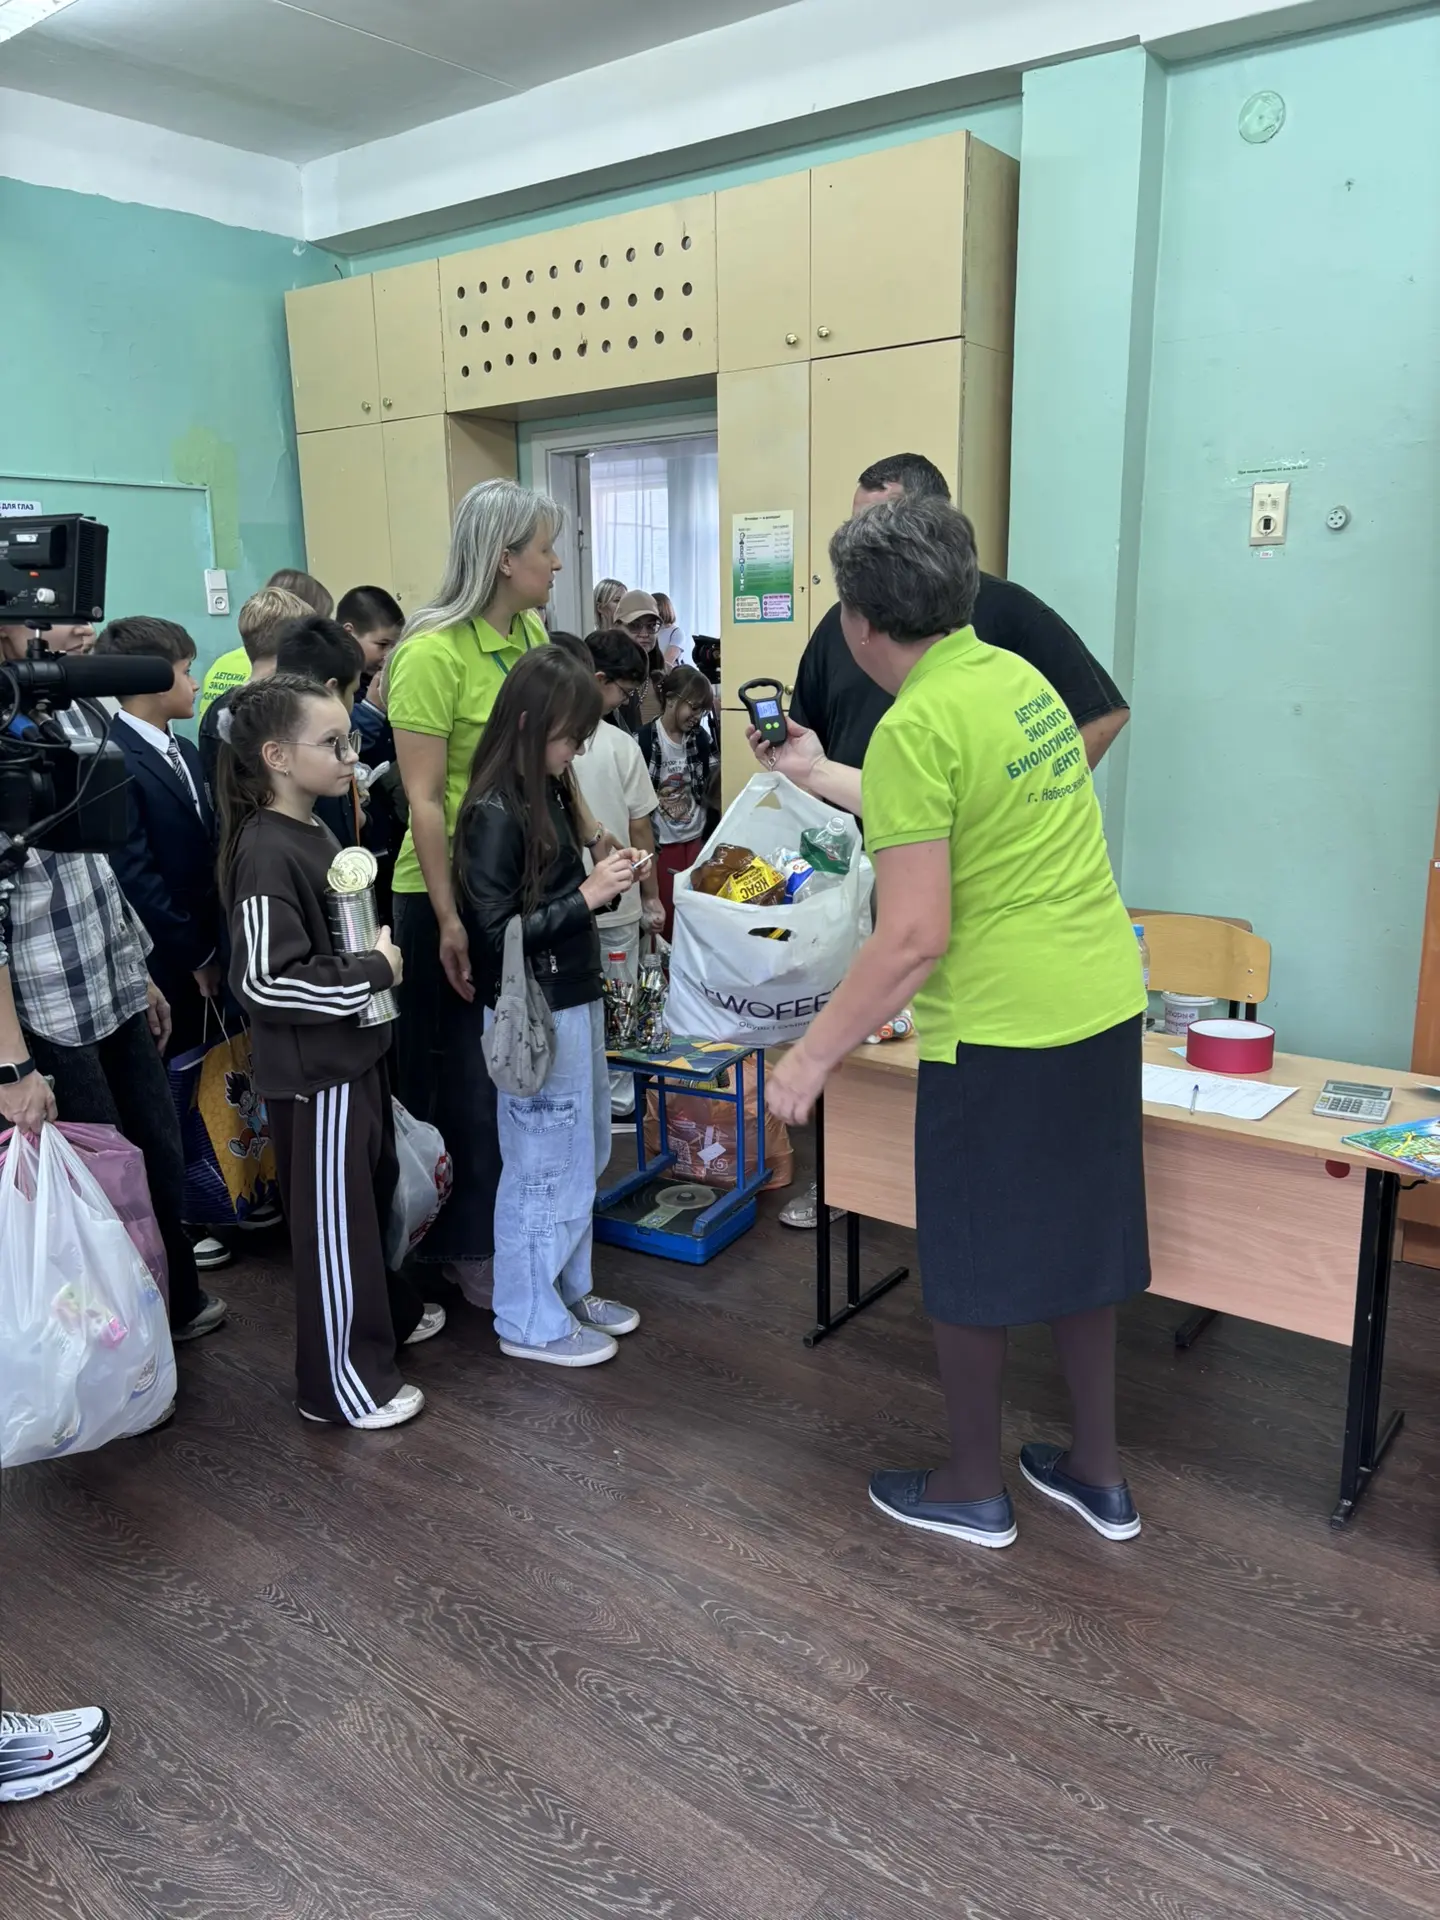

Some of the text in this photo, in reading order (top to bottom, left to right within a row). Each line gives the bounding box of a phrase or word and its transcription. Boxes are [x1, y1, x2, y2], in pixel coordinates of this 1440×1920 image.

[213, 671, 247, 682] ДЕТСКИЙ
[1014, 688, 1055, 726] ДЕТСКИЙ
[1052, 746, 1081, 778] ЦЕНТР
[740, 877, 770, 899] КВАС
